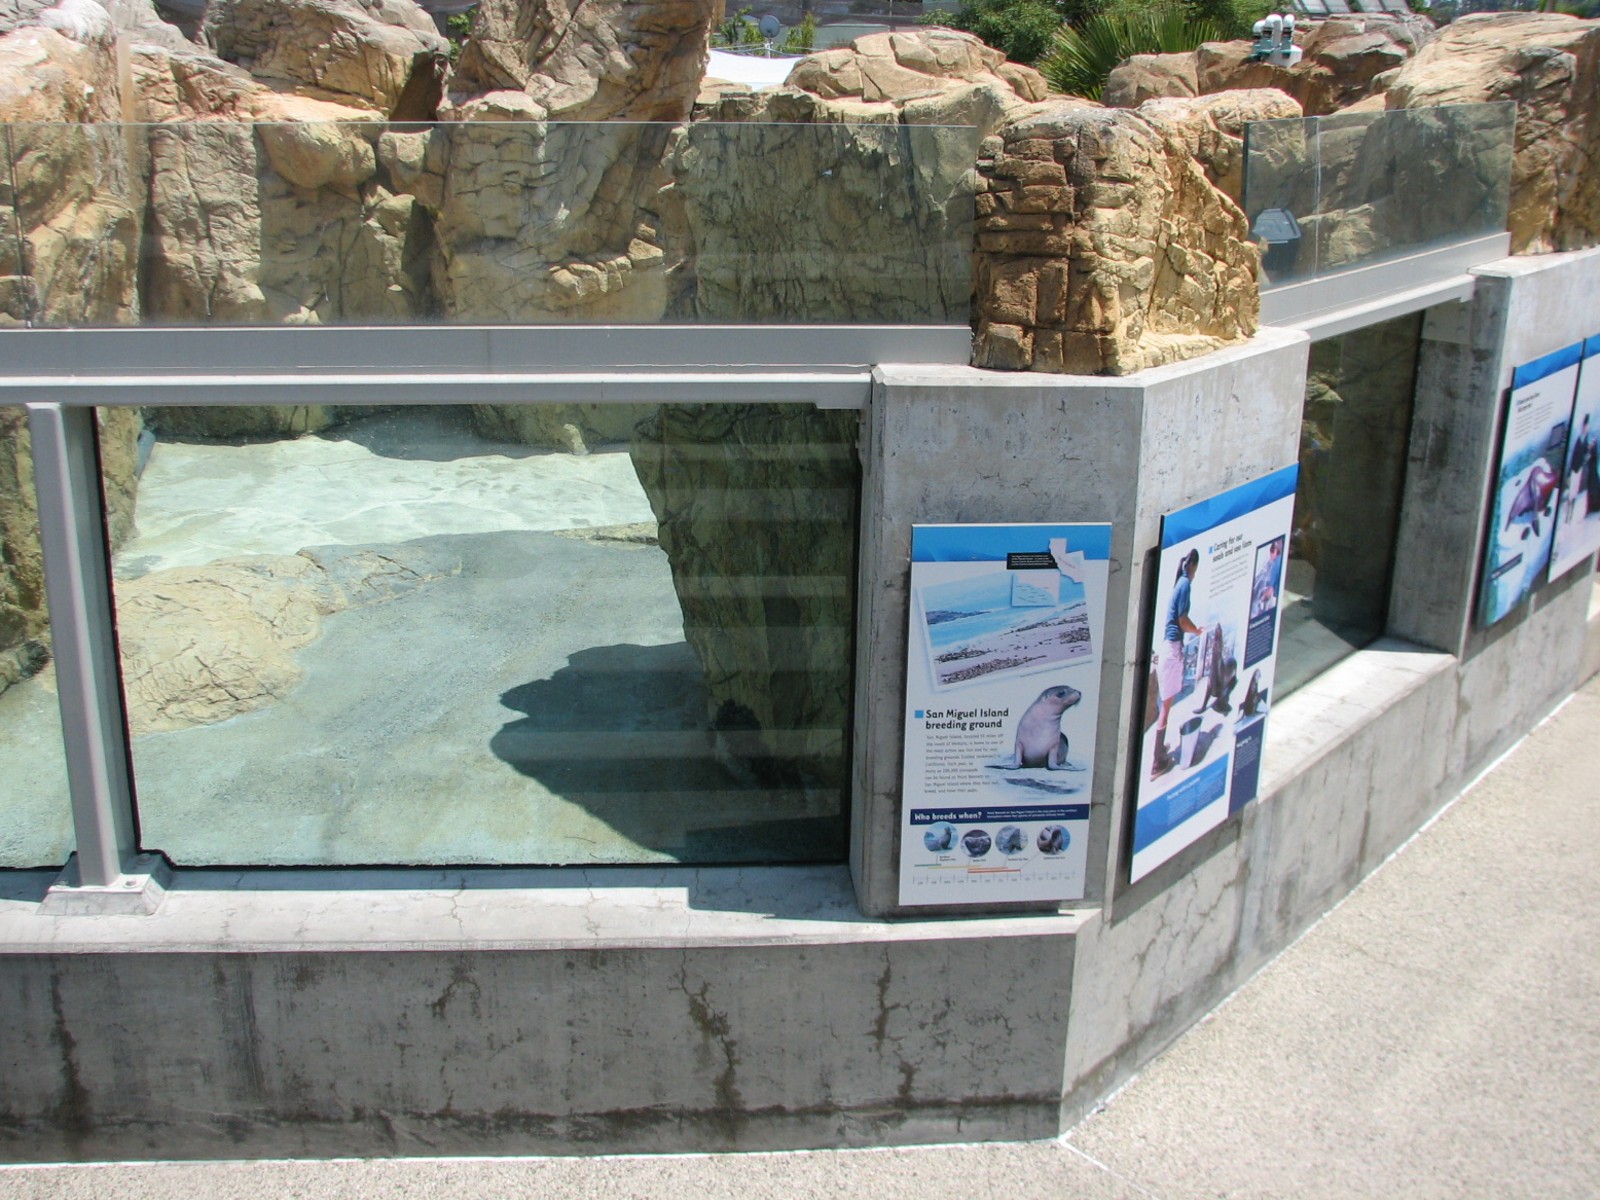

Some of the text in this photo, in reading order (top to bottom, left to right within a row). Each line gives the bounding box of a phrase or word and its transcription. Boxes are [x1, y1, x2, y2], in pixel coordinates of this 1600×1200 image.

[1225, 547, 1233, 557] and
[926, 708, 1009, 720] San Miguel Island
[926, 719, 1002, 731] breeding ground
[914, 812, 930, 821] Who
[932, 812, 957, 820] breeds
[958, 811, 982, 819] when?
